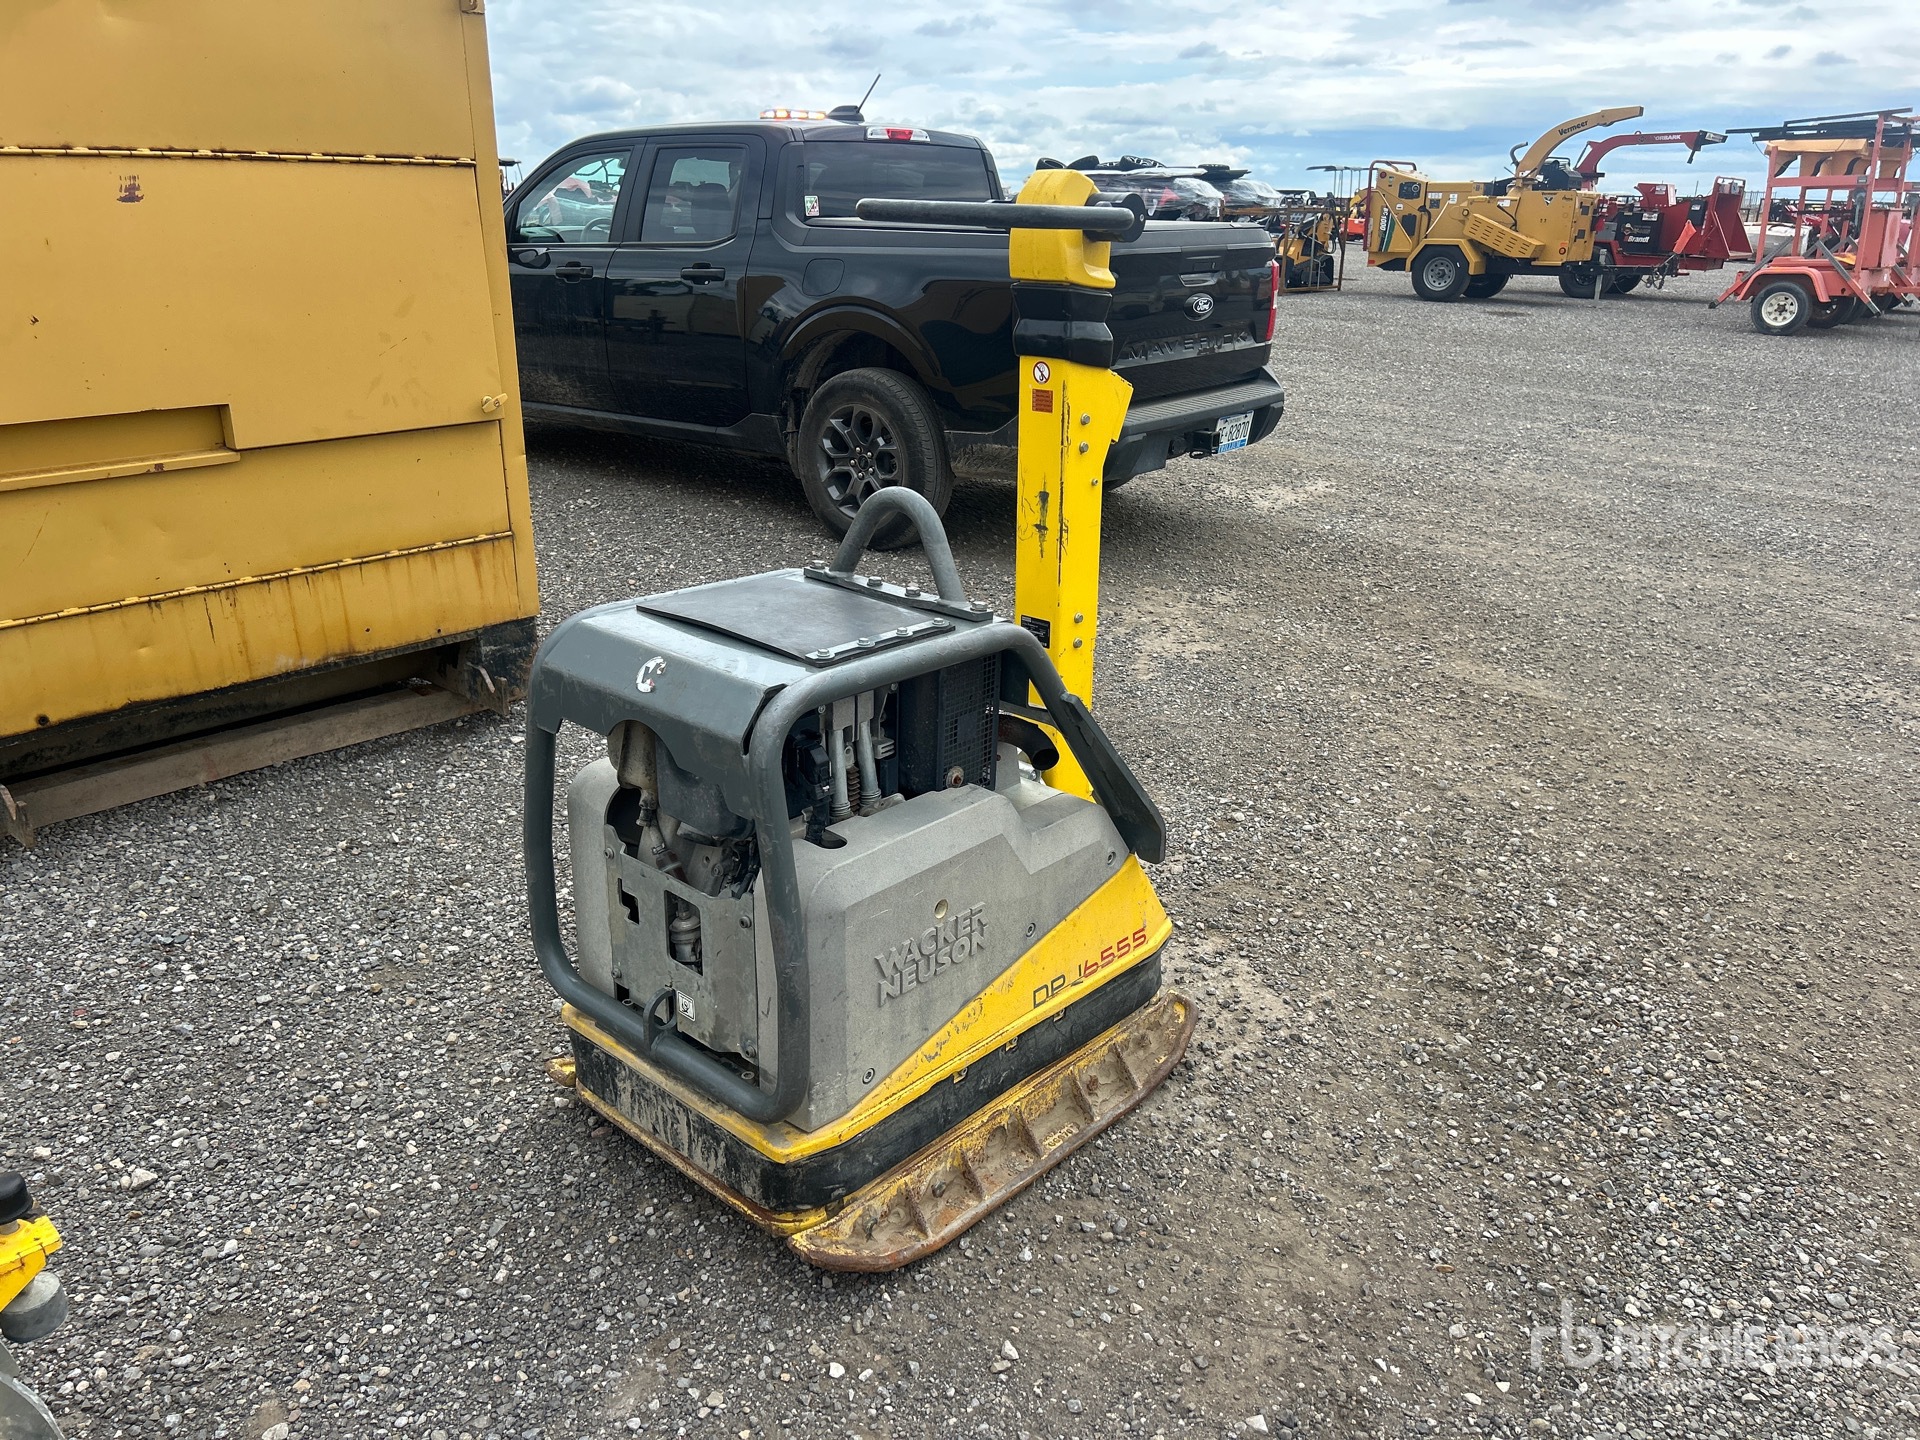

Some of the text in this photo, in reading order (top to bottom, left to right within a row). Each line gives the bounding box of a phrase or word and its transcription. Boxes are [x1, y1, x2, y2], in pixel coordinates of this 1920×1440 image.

[1558, 120, 1588, 135] Vermeer
[873, 901, 989, 979] WACKER
[878, 932, 986, 1007] NEUSON
